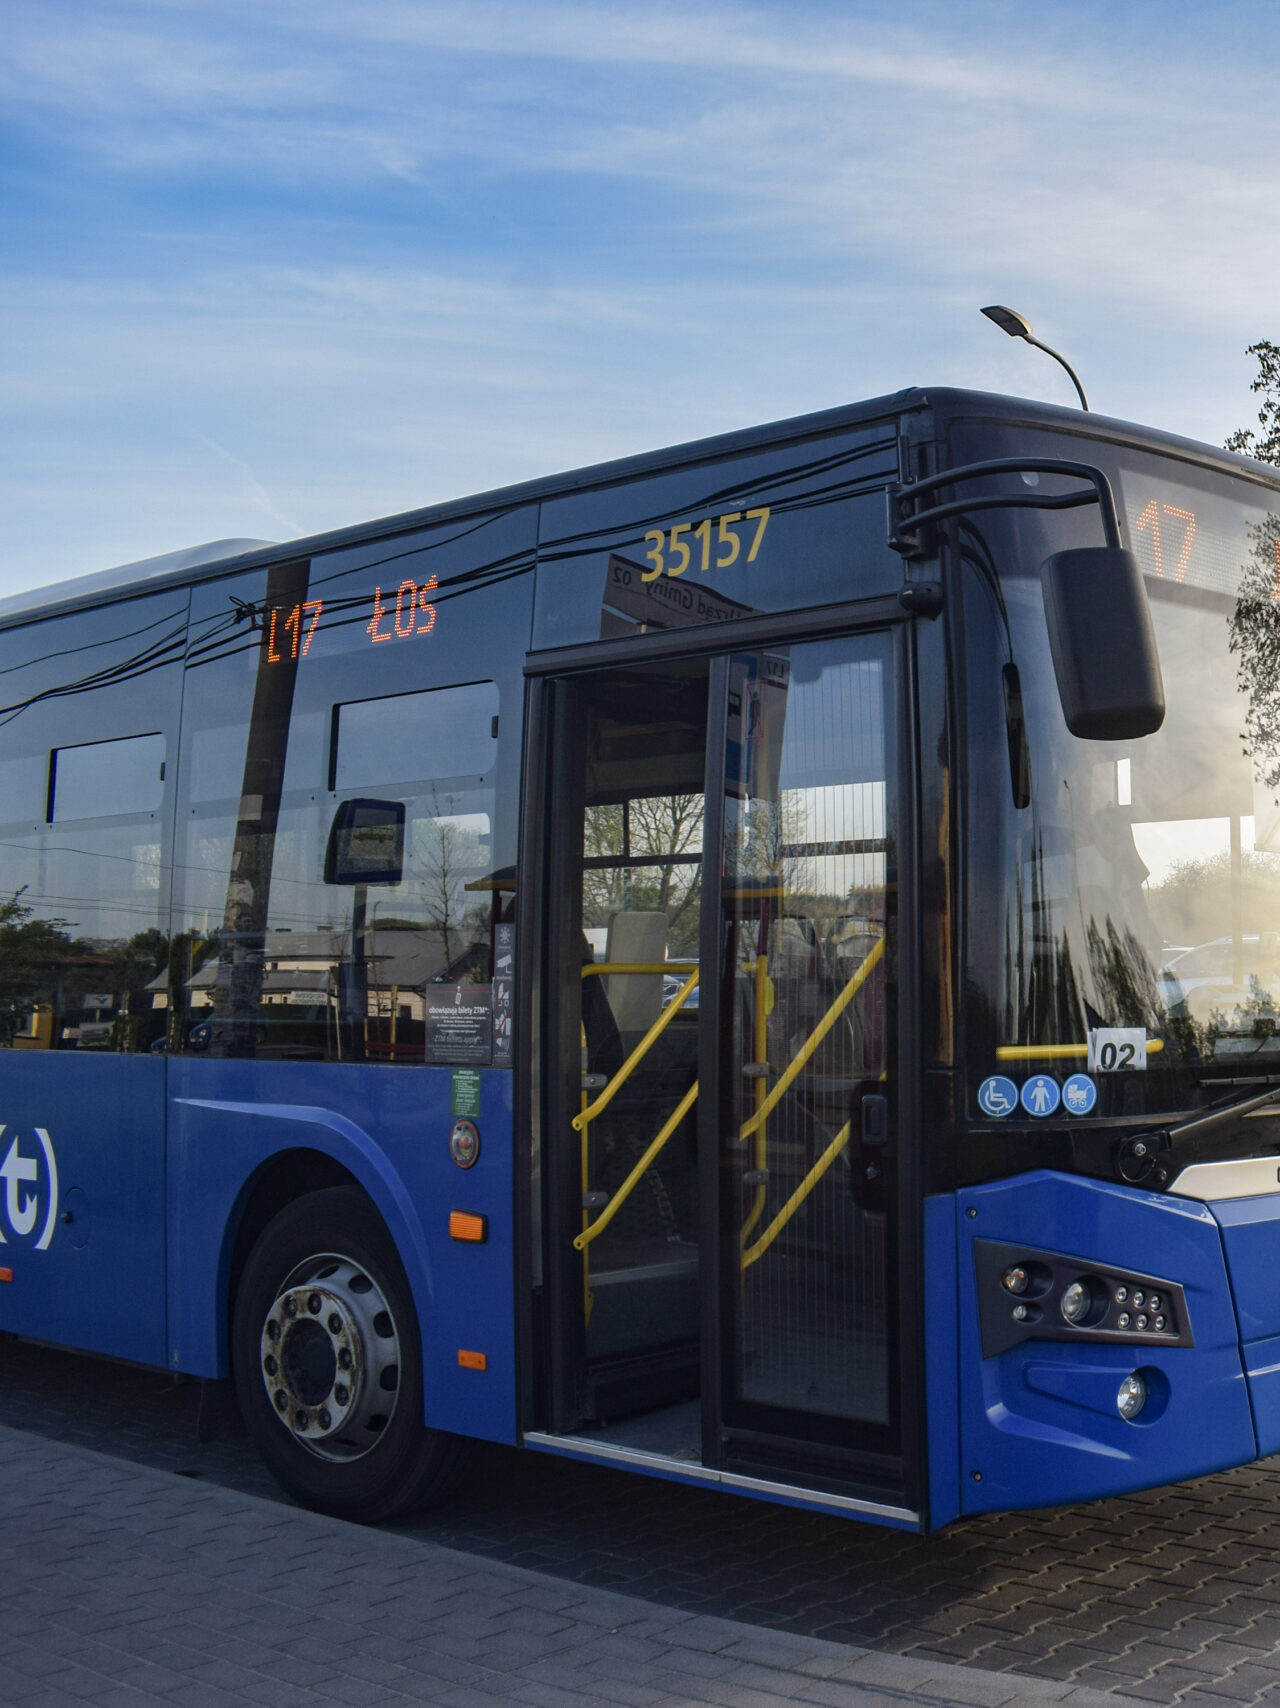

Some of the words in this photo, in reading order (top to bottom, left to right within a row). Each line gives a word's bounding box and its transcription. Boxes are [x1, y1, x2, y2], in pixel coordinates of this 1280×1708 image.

[641, 507, 771, 582] 35157
[268, 600, 322, 663] L17
[366, 574, 438, 642] ŁOŚ
[1101, 1043, 1135, 1070] 02
